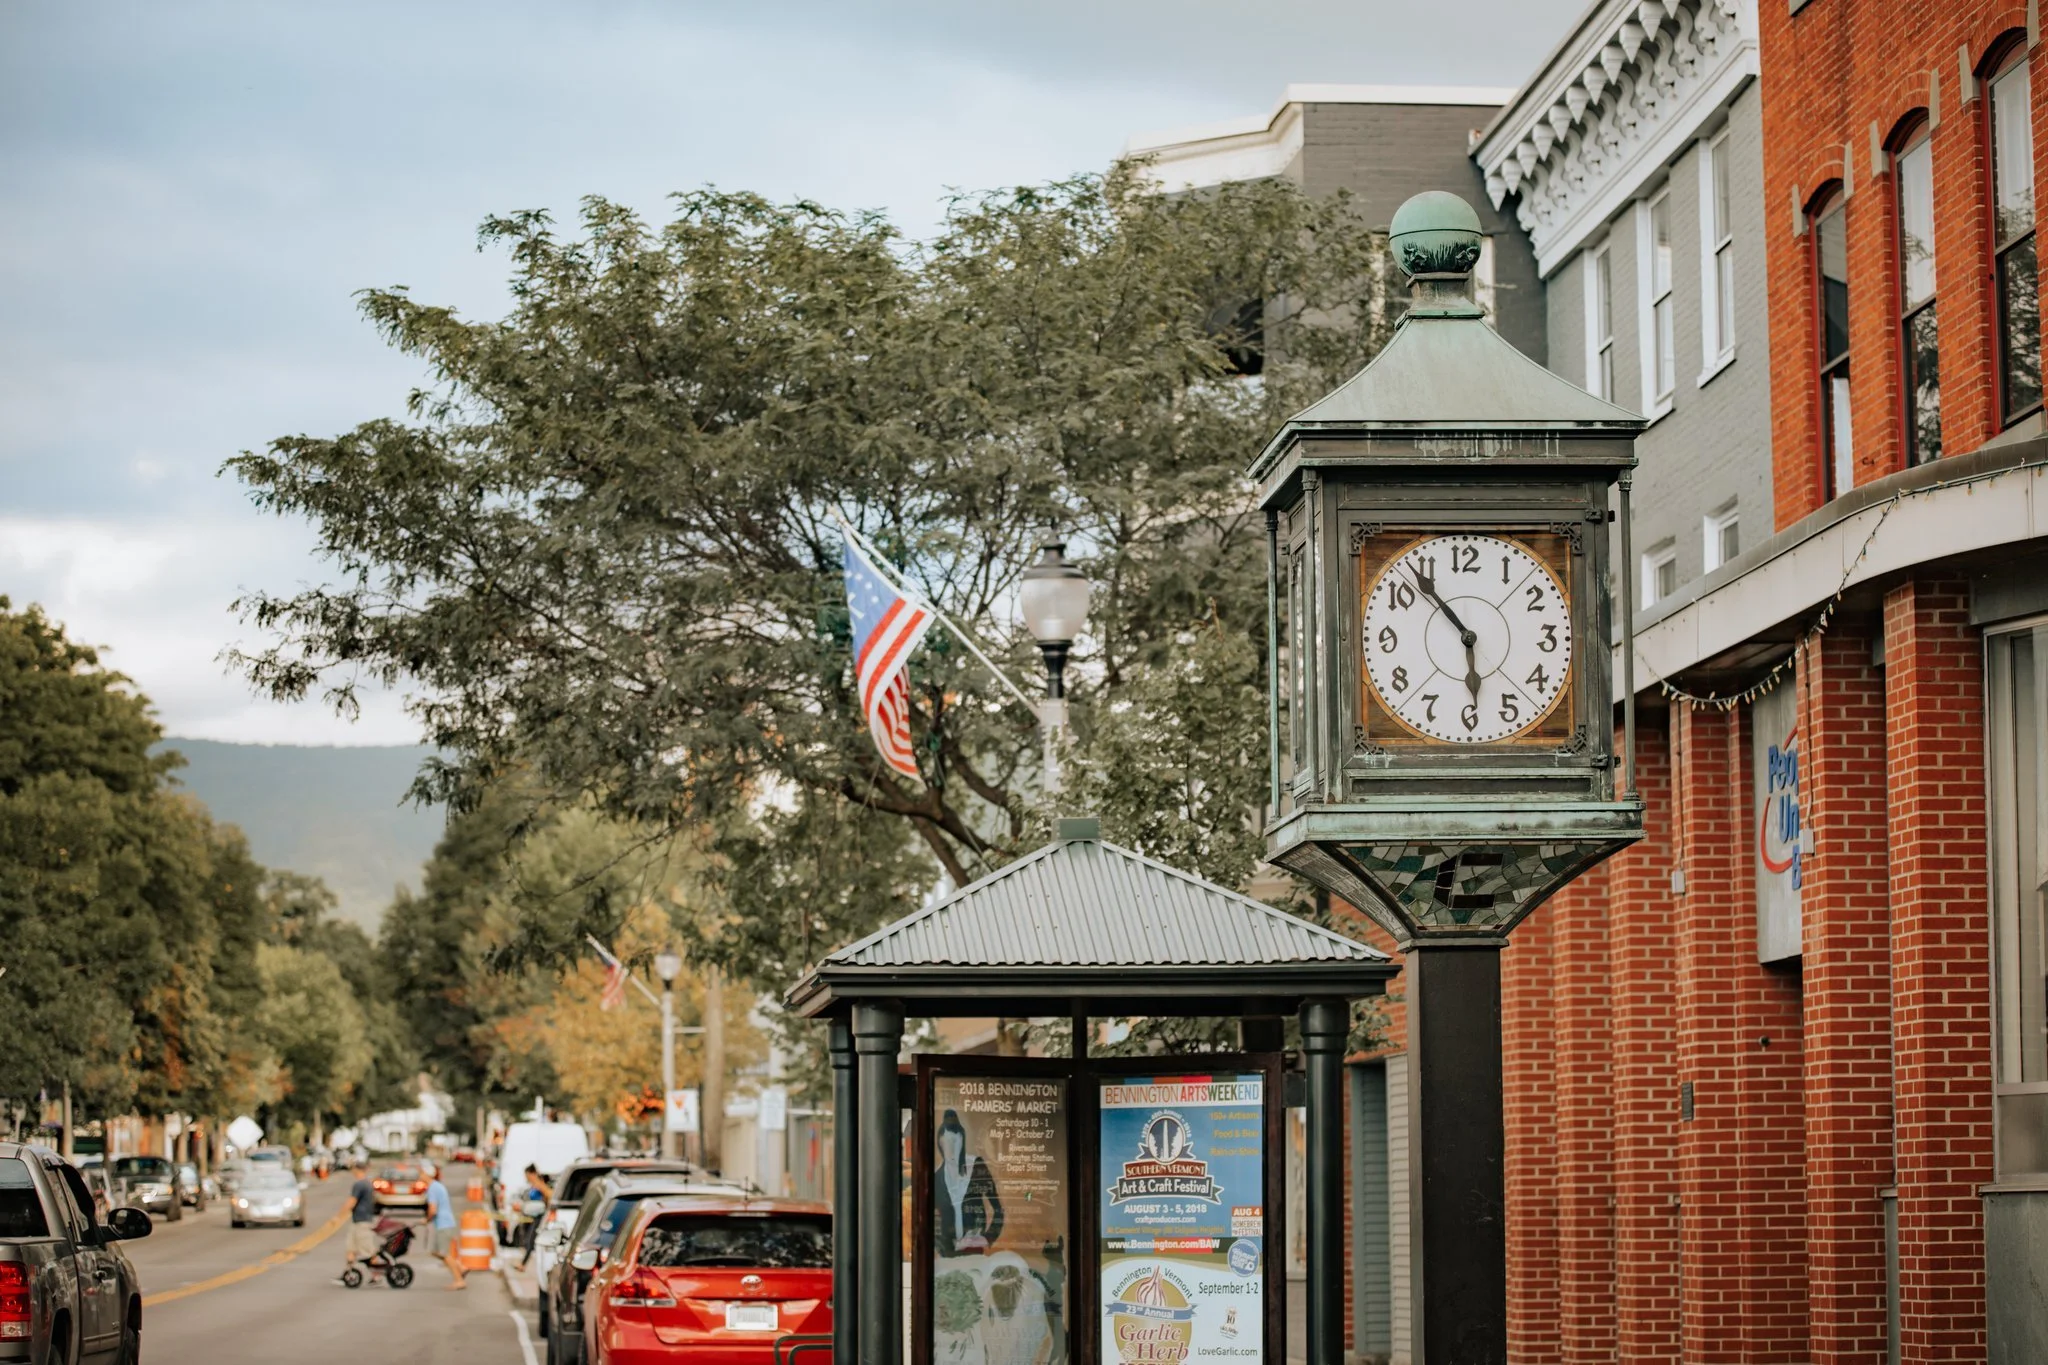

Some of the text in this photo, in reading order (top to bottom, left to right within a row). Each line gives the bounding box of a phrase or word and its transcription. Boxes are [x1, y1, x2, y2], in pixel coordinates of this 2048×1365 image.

[1451, 544, 1481, 574] 12
[1502, 556, 1510, 584] 1
[1388, 580, 1415, 611] 10
[1526, 584, 1545, 612] 2
[1379, 625, 1398, 653] 9
[1536, 624, 1557, 652] 3
[1392, 666, 1409, 693] 8
[1525, 664, 1549, 694] 4
[1421, 694, 1439, 723] 7
[1499, 693, 1519, 722] 5
[1461, 704, 1478, 732] 6
[960, 1083, 1058, 1096] 2018 BENNINGTON
[964, 1100, 1058, 1113] FARMERS' MARKET
[996, 1118, 1029, 1129] Saturdays
[989, 1129, 1004, 1141] May
[1016, 1130, 1044, 1139] October
[1046, 1130, 1054, 1138] 27
[1127, 1164, 1206, 1176] SOUTHERN VERMONT
[1122, 1178, 1210, 1194] Art & Craft Festival
[1124, 1204, 1160, 1214] AUGUST
[1162, 1204, 1168, 1213] 3
[1176, 1204, 1184, 1214] 5,
[1186, 1204, 1207, 1213] 2018
[1234, 1208, 1260, 1216] AUG 4
[1107, 1239, 1220, 1250] www.Bennington.com/BAW
[1112, 1266, 1193, 1299] Bennington Vermont
[1199, 1282, 1258, 1296] September 1-2
[1144, 1306, 1174, 1319] Annual
[1120, 1324, 1181, 1341] Garlic
[1137, 1342, 1189, 1360] Herb
[1198, 1347, 1258, 1356] LoveGarlic.com
